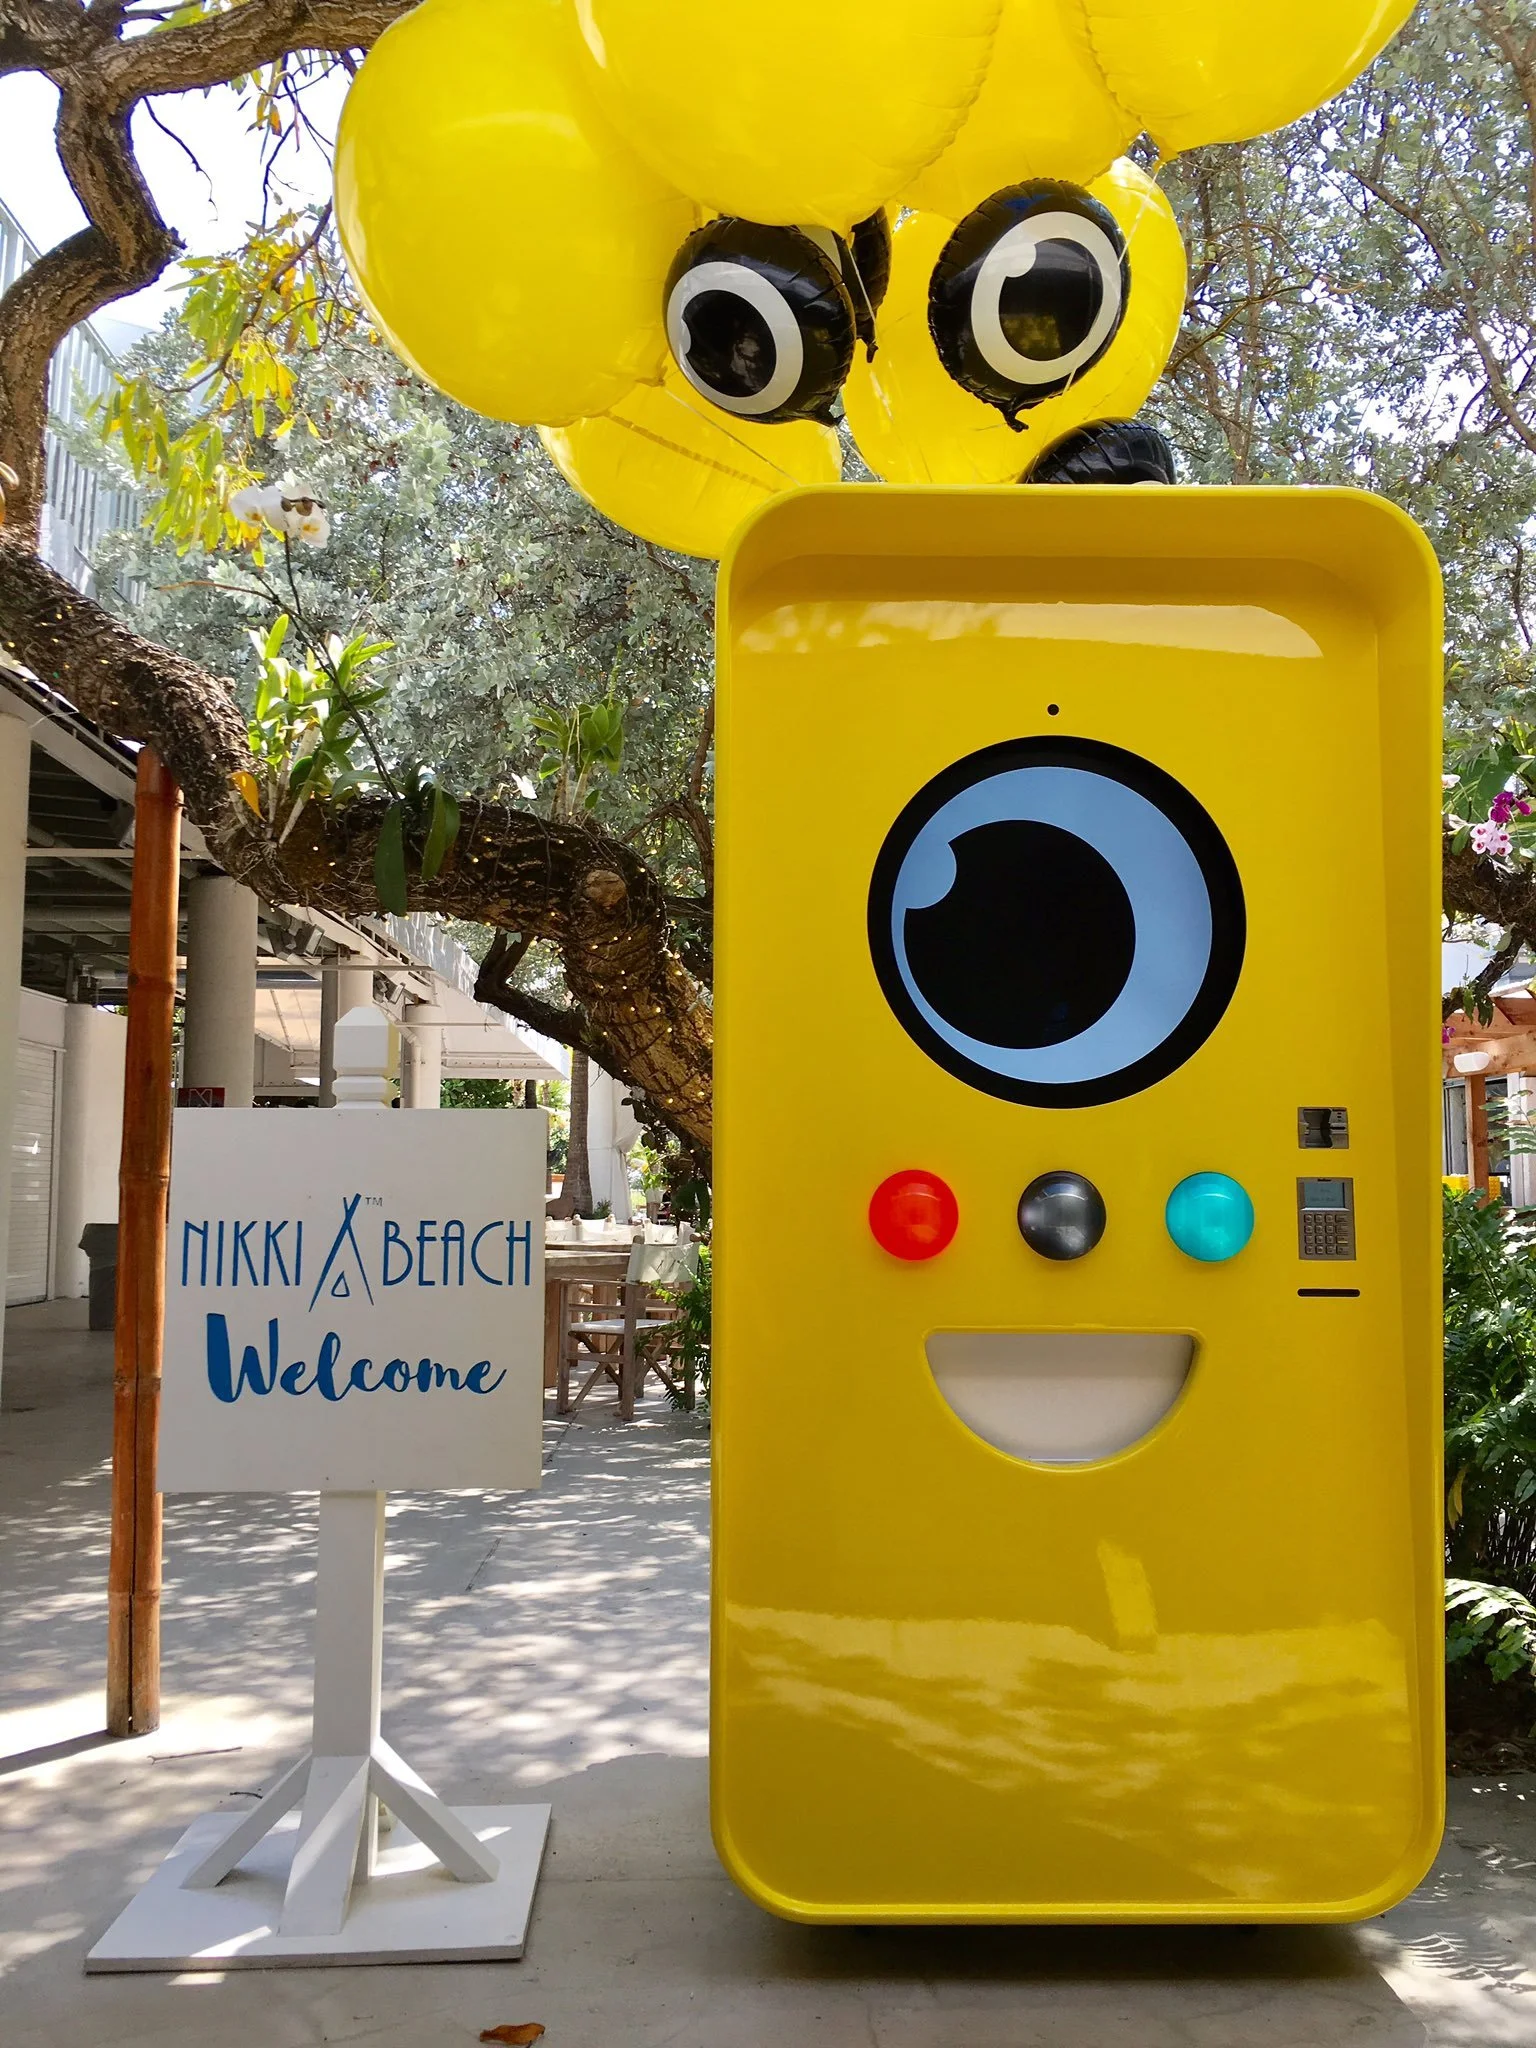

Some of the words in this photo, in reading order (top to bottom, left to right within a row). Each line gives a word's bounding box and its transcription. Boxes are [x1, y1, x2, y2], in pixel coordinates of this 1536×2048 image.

[181, 1219, 303, 1287] NIKKI
[382, 1219, 532, 1287] BEACH
[206, 1312, 508, 1404] Welcome
